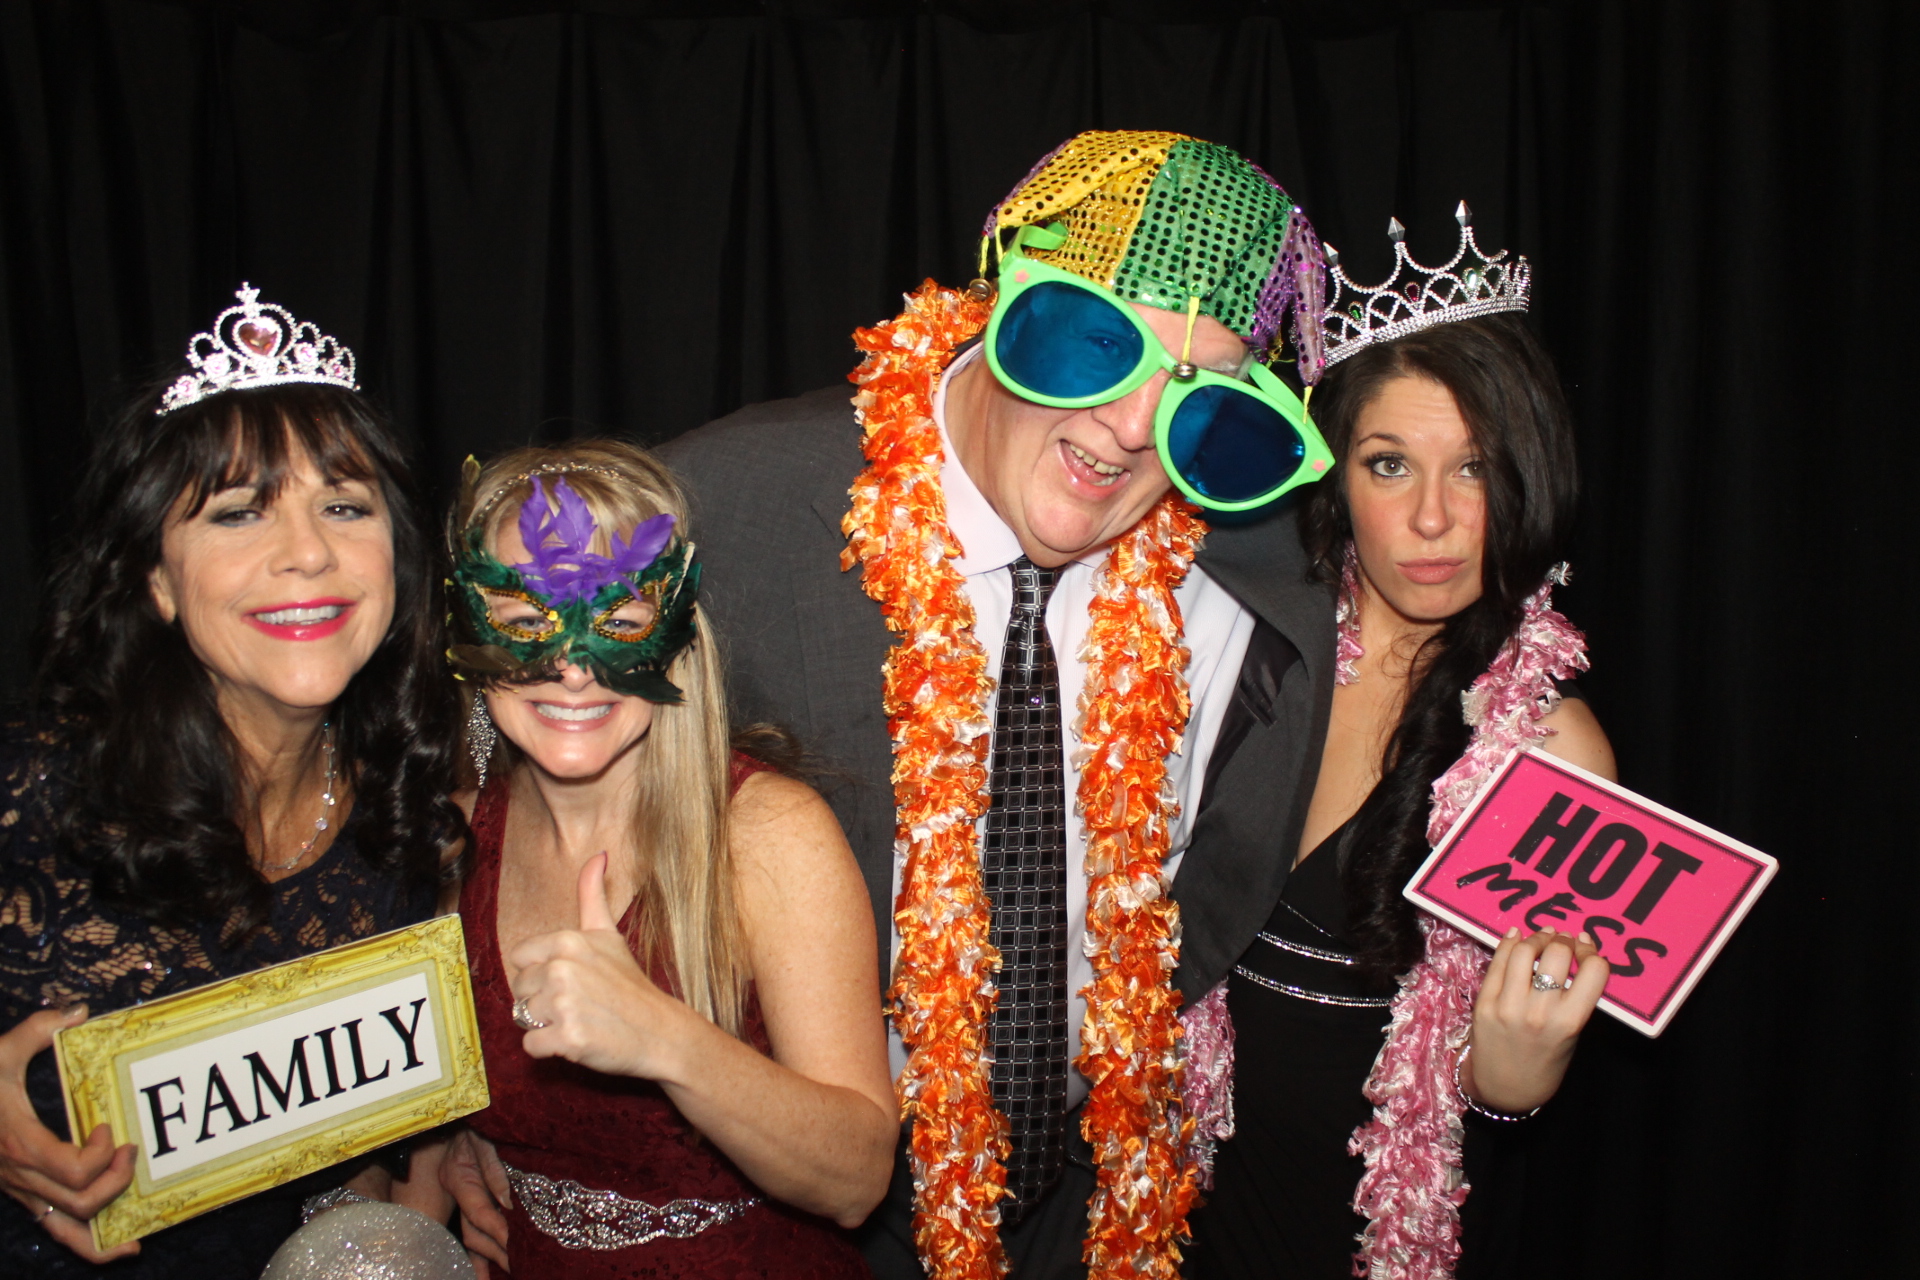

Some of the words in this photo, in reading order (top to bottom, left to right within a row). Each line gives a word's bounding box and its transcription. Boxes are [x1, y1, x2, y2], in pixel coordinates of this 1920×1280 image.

[1457, 862, 1668, 978] MESS
[1508, 791, 1703, 925] HOT
[140, 997, 427, 1159] FAMILY
